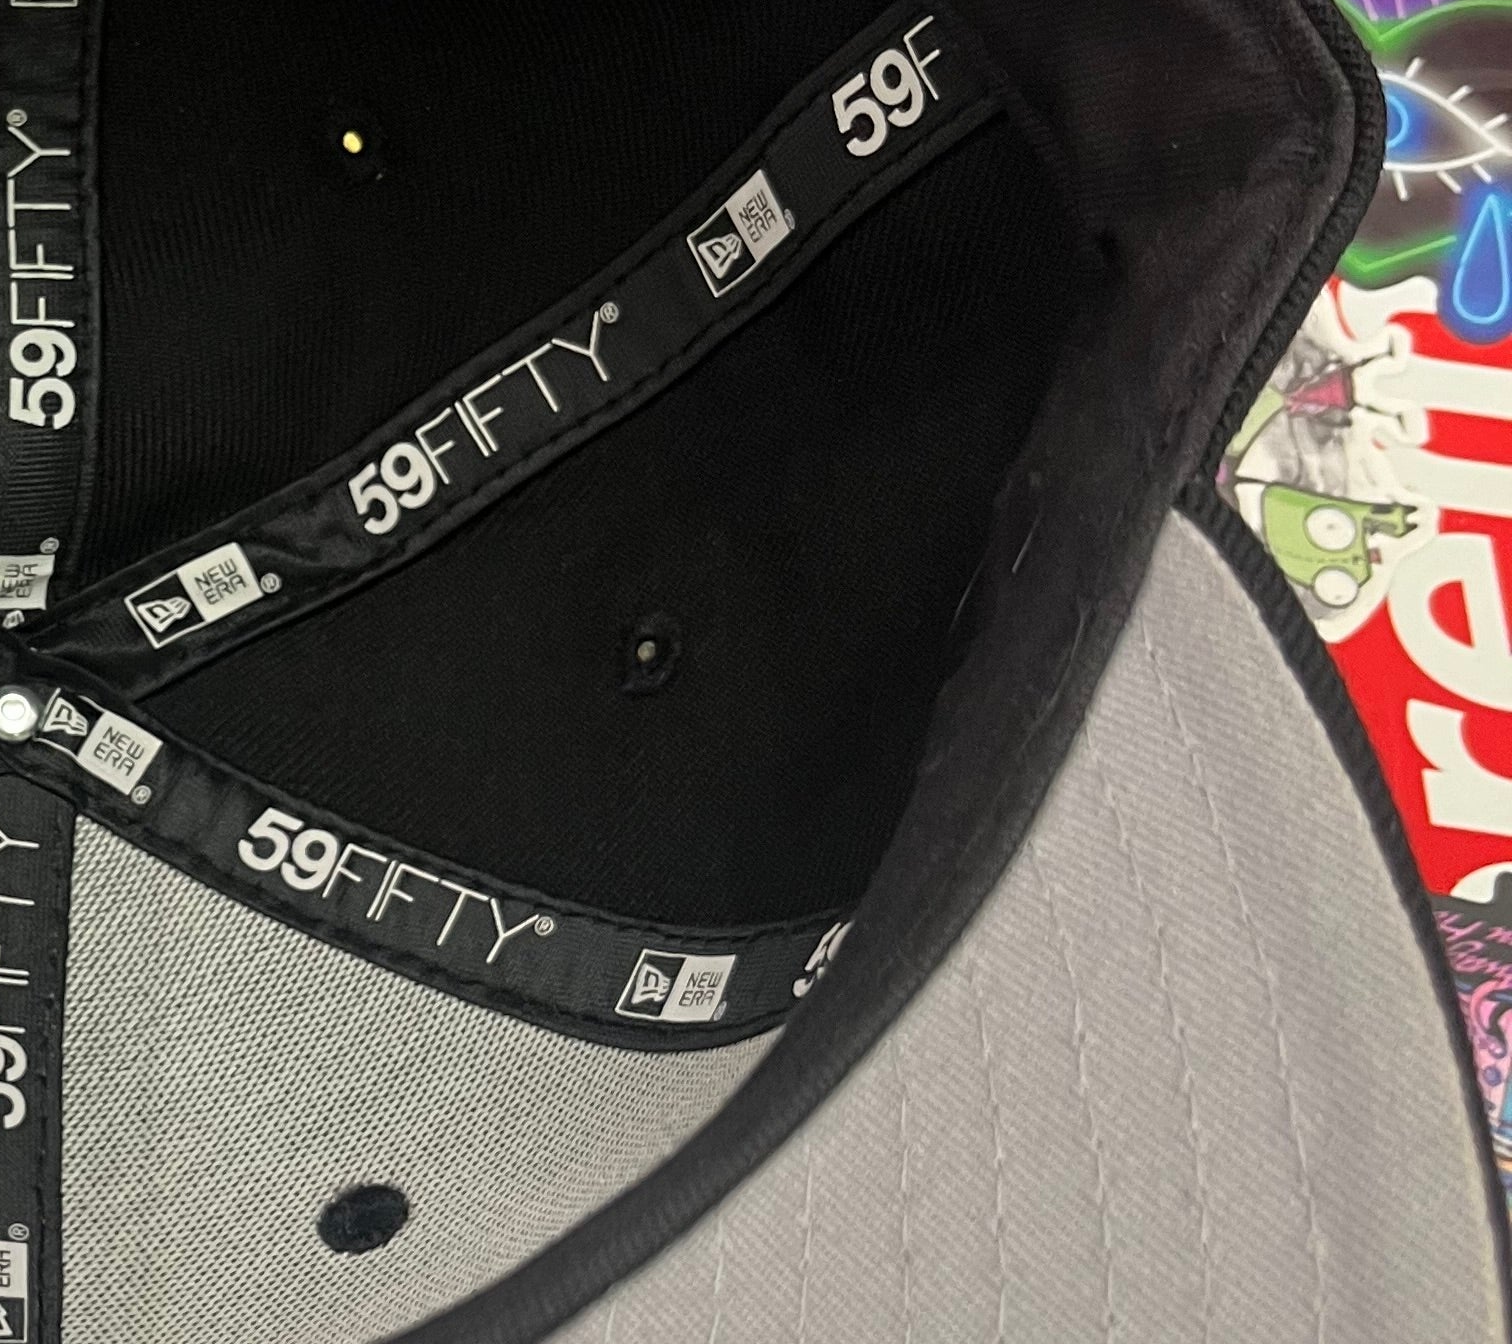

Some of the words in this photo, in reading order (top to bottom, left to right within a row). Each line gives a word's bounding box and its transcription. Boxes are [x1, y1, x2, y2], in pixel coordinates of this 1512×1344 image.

[738, 189, 769, 224] NEW
[747, 210, 778, 244] ERA
[7, 125, 78, 430] 59FIFTY
[348, 311, 608, 536] 59FIFTY
[194, 558, 238, 592] NEW
[203, 574, 248, 606] ERA
[103, 725, 146, 758] NEW
[93, 742, 138, 778] ERA
[237, 806, 541, 964] 59FIFTY
[685, 970, 723, 989] NEW
[678, 989, 717, 1008] ERA
